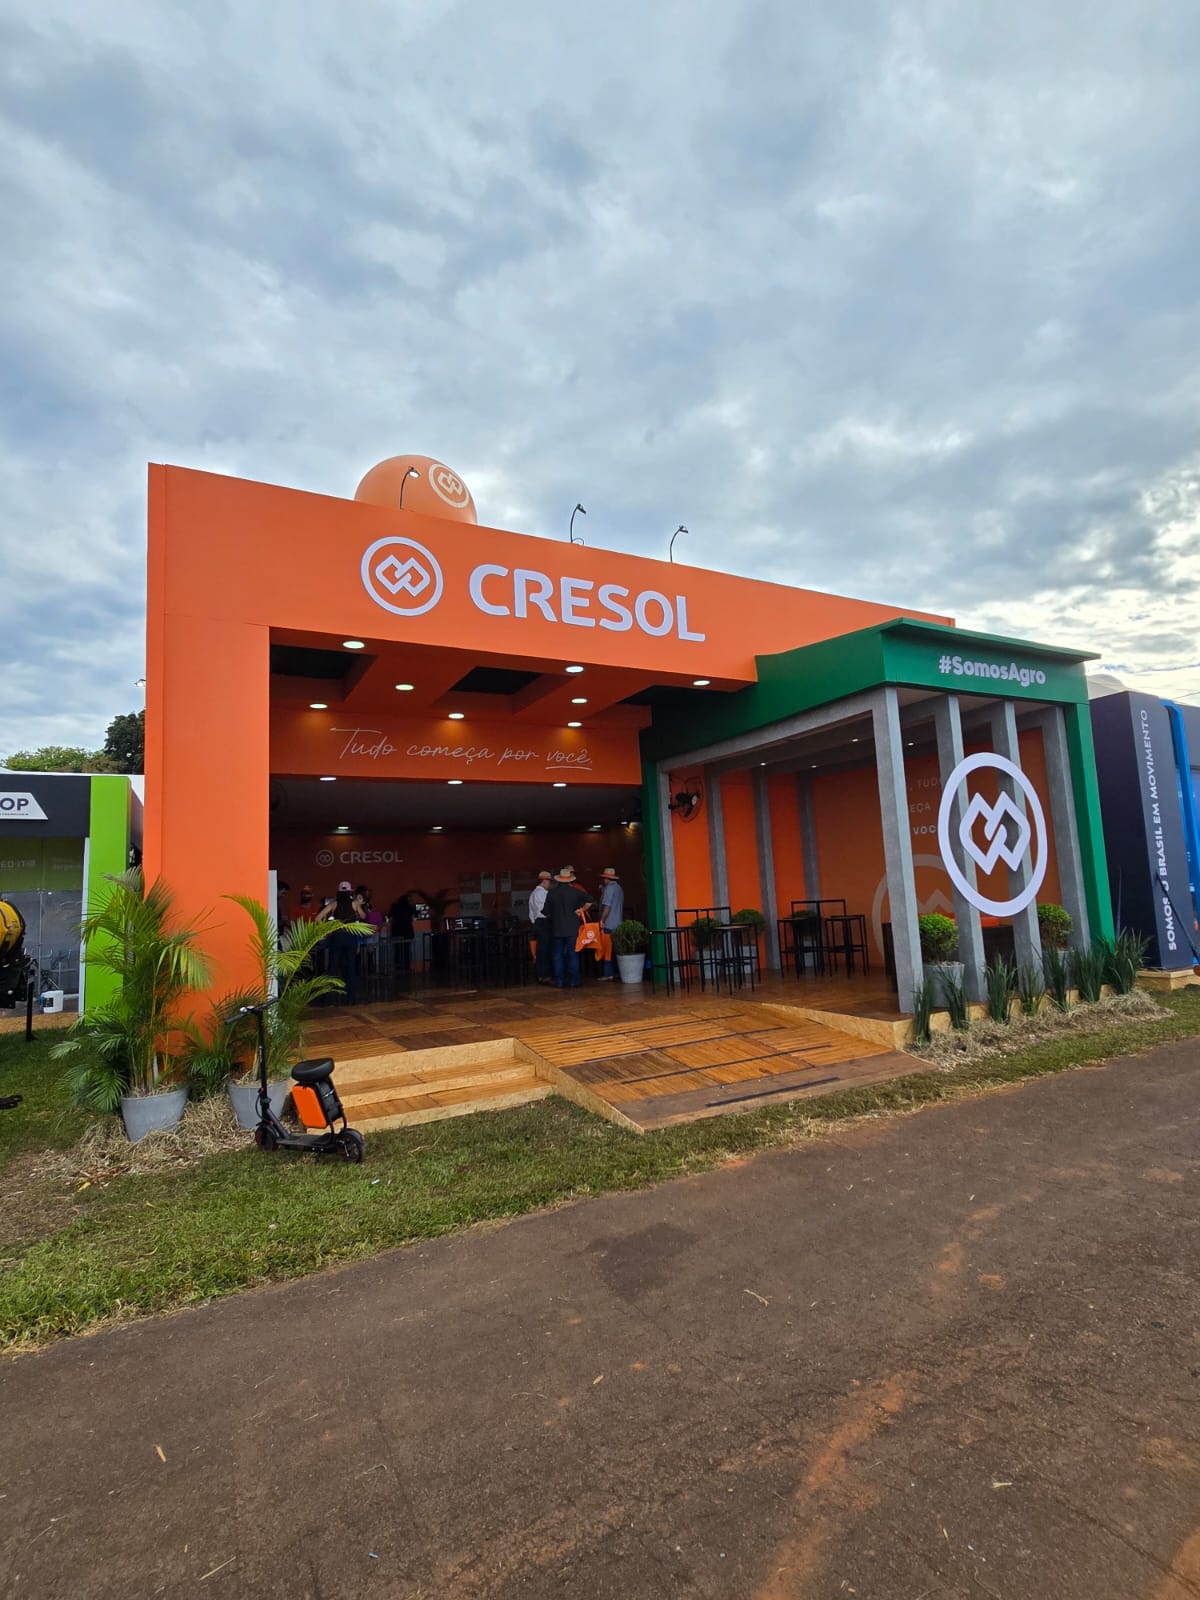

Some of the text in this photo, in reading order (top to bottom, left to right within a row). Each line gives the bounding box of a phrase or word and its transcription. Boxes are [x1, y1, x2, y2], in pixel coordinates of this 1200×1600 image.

[469, 563, 706, 642] CRESOL
[938, 655, 1046, 688] #SomosAgro
[329, 727, 398, 760] Tudo
[406, 743, 496, 765] começa
[497, 747, 540, 766] por
[1140, 709, 1159, 799] MOVIMENTO
[917, 777, 939, 790] TUD
[910, 802, 931, 814] EÇA
[1151, 803, 1162, 824] EM
[912, 824, 937, 835] VOC
[340, 850, 404, 864] CRESOL
[1154, 826, 1168, 876] BRASIL
[1162, 896, 1177, 951] SOMOS
